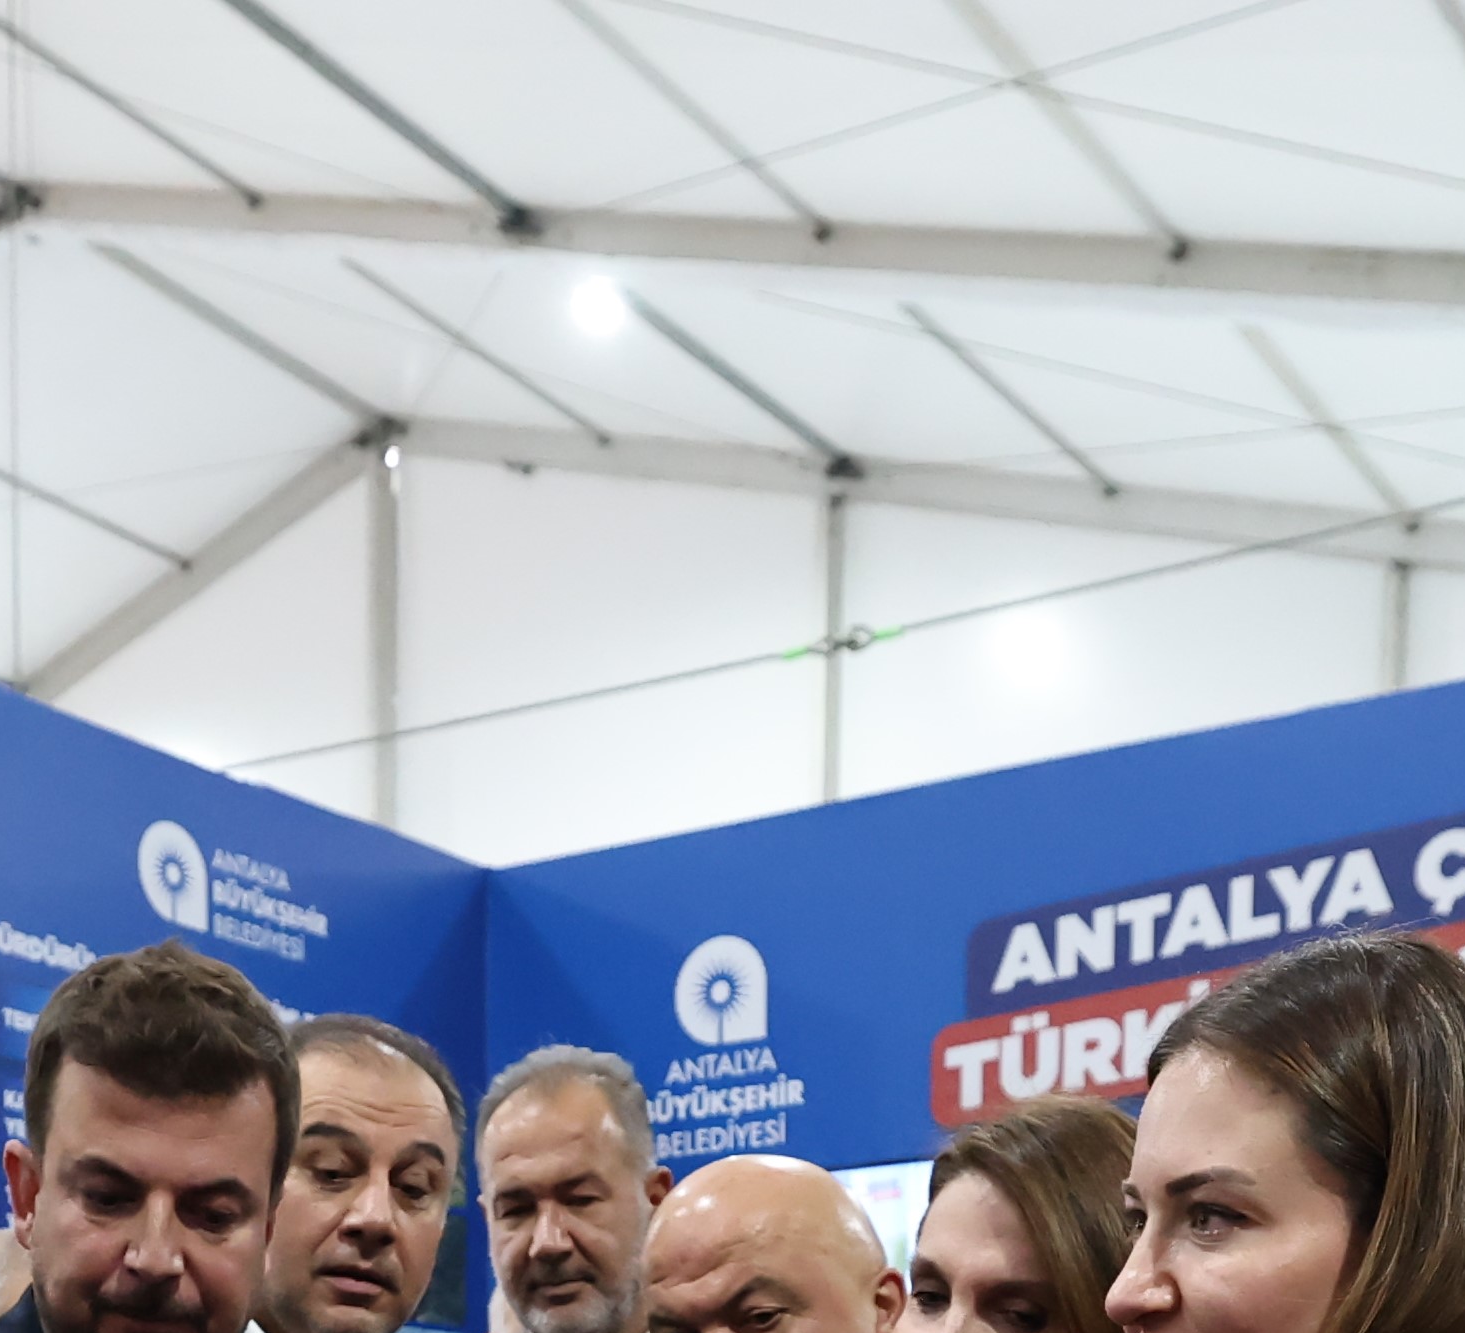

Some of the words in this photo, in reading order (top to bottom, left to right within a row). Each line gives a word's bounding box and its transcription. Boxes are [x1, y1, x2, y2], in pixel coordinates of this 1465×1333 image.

[991, 847, 1395, 995] ANTALYA
[664, 1046, 778, 1086] ANTALYA
[943, 977, 1212, 1112] TÜRK
[656, 1111, 787, 1161] BELEDİYESİ
